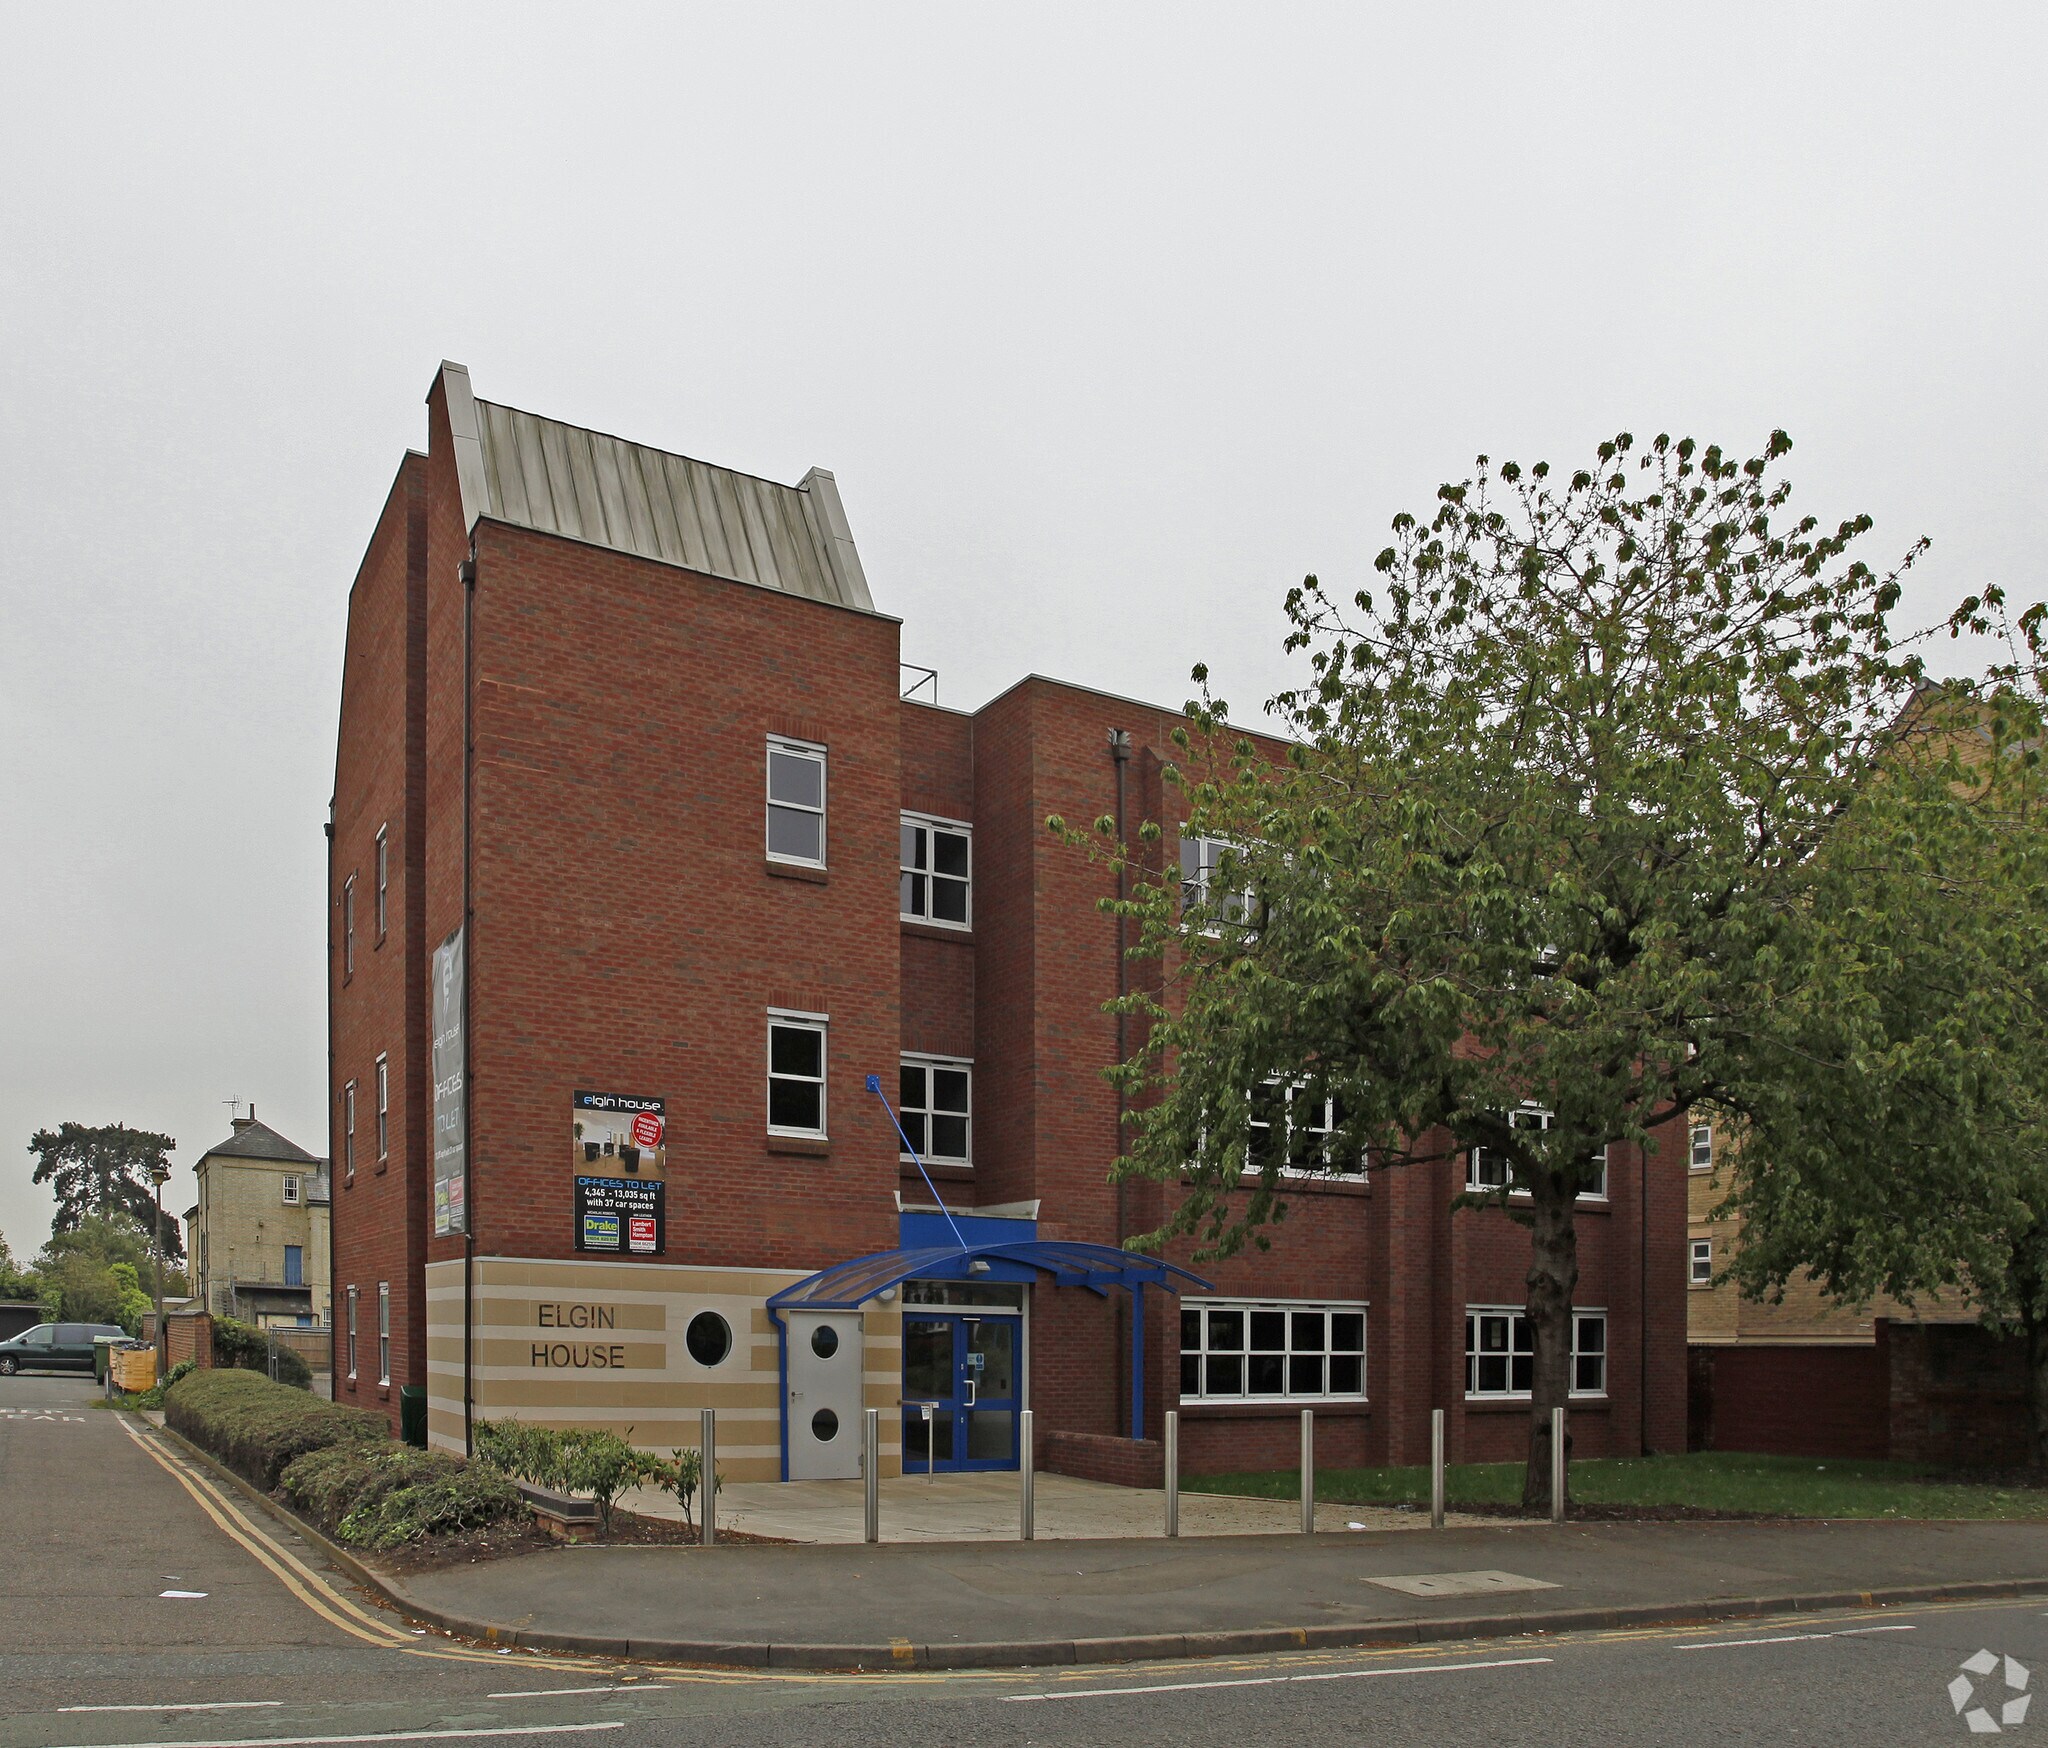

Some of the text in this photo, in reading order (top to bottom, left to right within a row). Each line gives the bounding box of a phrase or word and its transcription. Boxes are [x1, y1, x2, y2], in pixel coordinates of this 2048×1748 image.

[583, 1095, 661, 1111] elgin house
[578, 1177, 662, 1190] OFFICES TO LET
[584, 1187, 605, 1197] 4,345
[614, 1189, 638, 1199] 13,035
[639, 1192, 648, 1201] sq
[649, 1191, 656, 1200] ft
[586, 1198, 603, 1207] with
[604, 1199, 614, 1207] 37
[628, 1202, 654, 1210] spaces
[586, 1219, 618, 1231] Drake
[632, 1220, 651, 1228] Lambert
[539, 1304, 614, 1329] ELGIN
[531, 1343, 625, 1369] HOUSE
